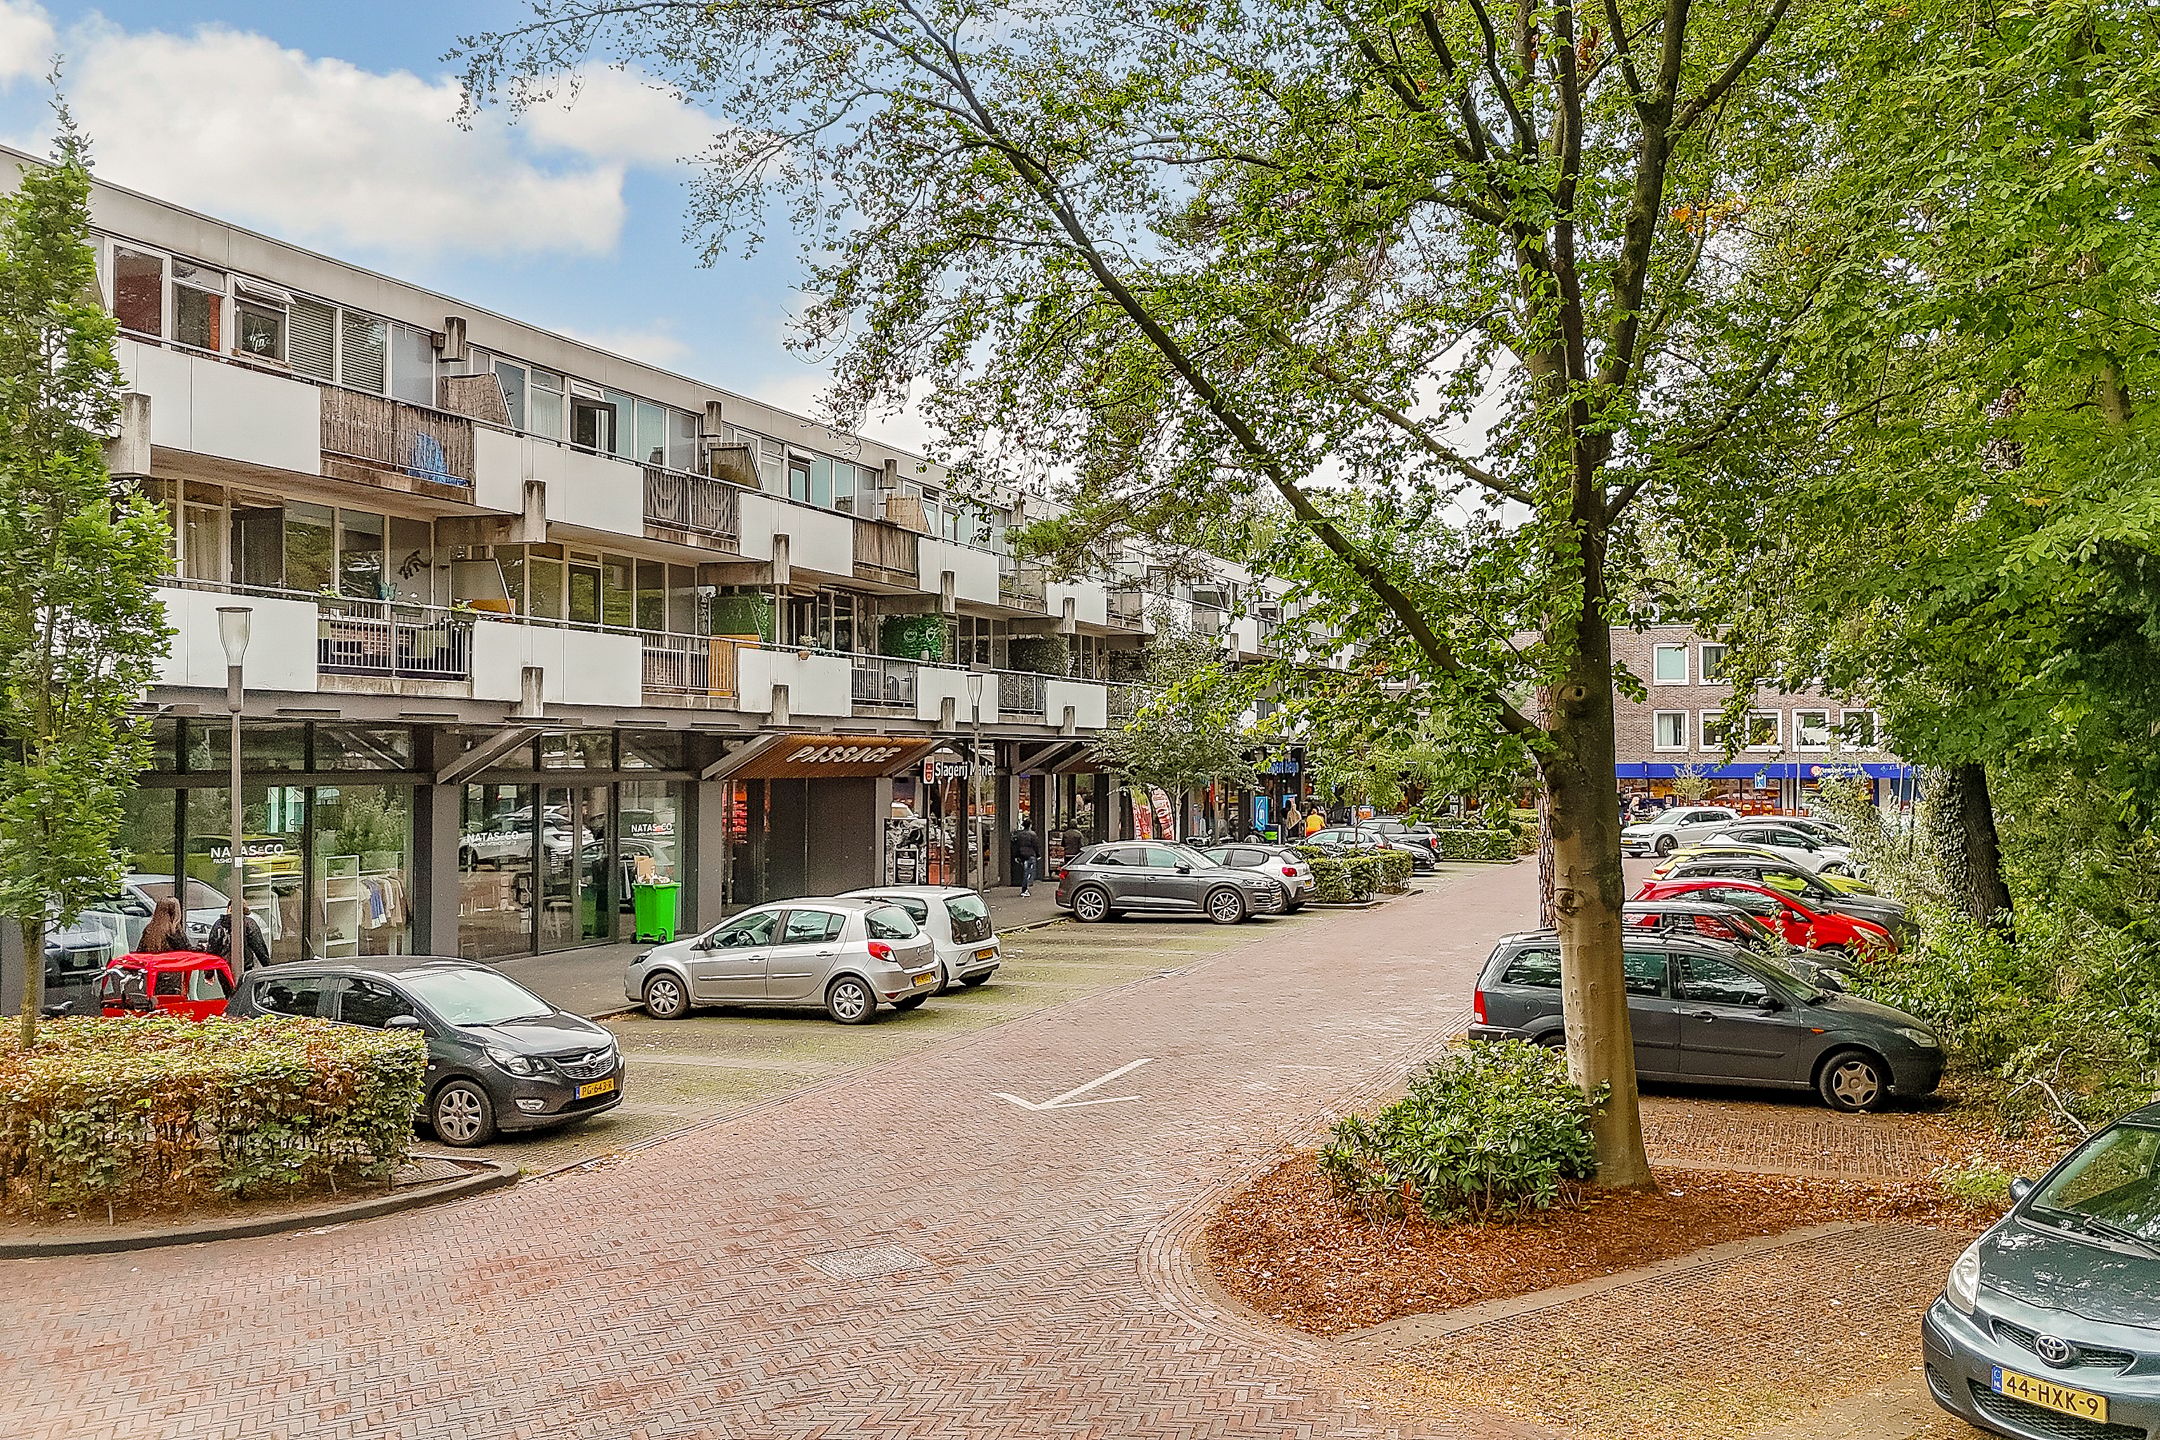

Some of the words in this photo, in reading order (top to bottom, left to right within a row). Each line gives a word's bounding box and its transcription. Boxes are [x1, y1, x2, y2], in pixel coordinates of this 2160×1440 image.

[786, 746, 901, 762] PASSAGE
[935, 761, 968, 780] Slagerij
[210, 844, 284, 859] NAAS&CO
[2006, 1376, 2099, 1416] 44-HXK-9
